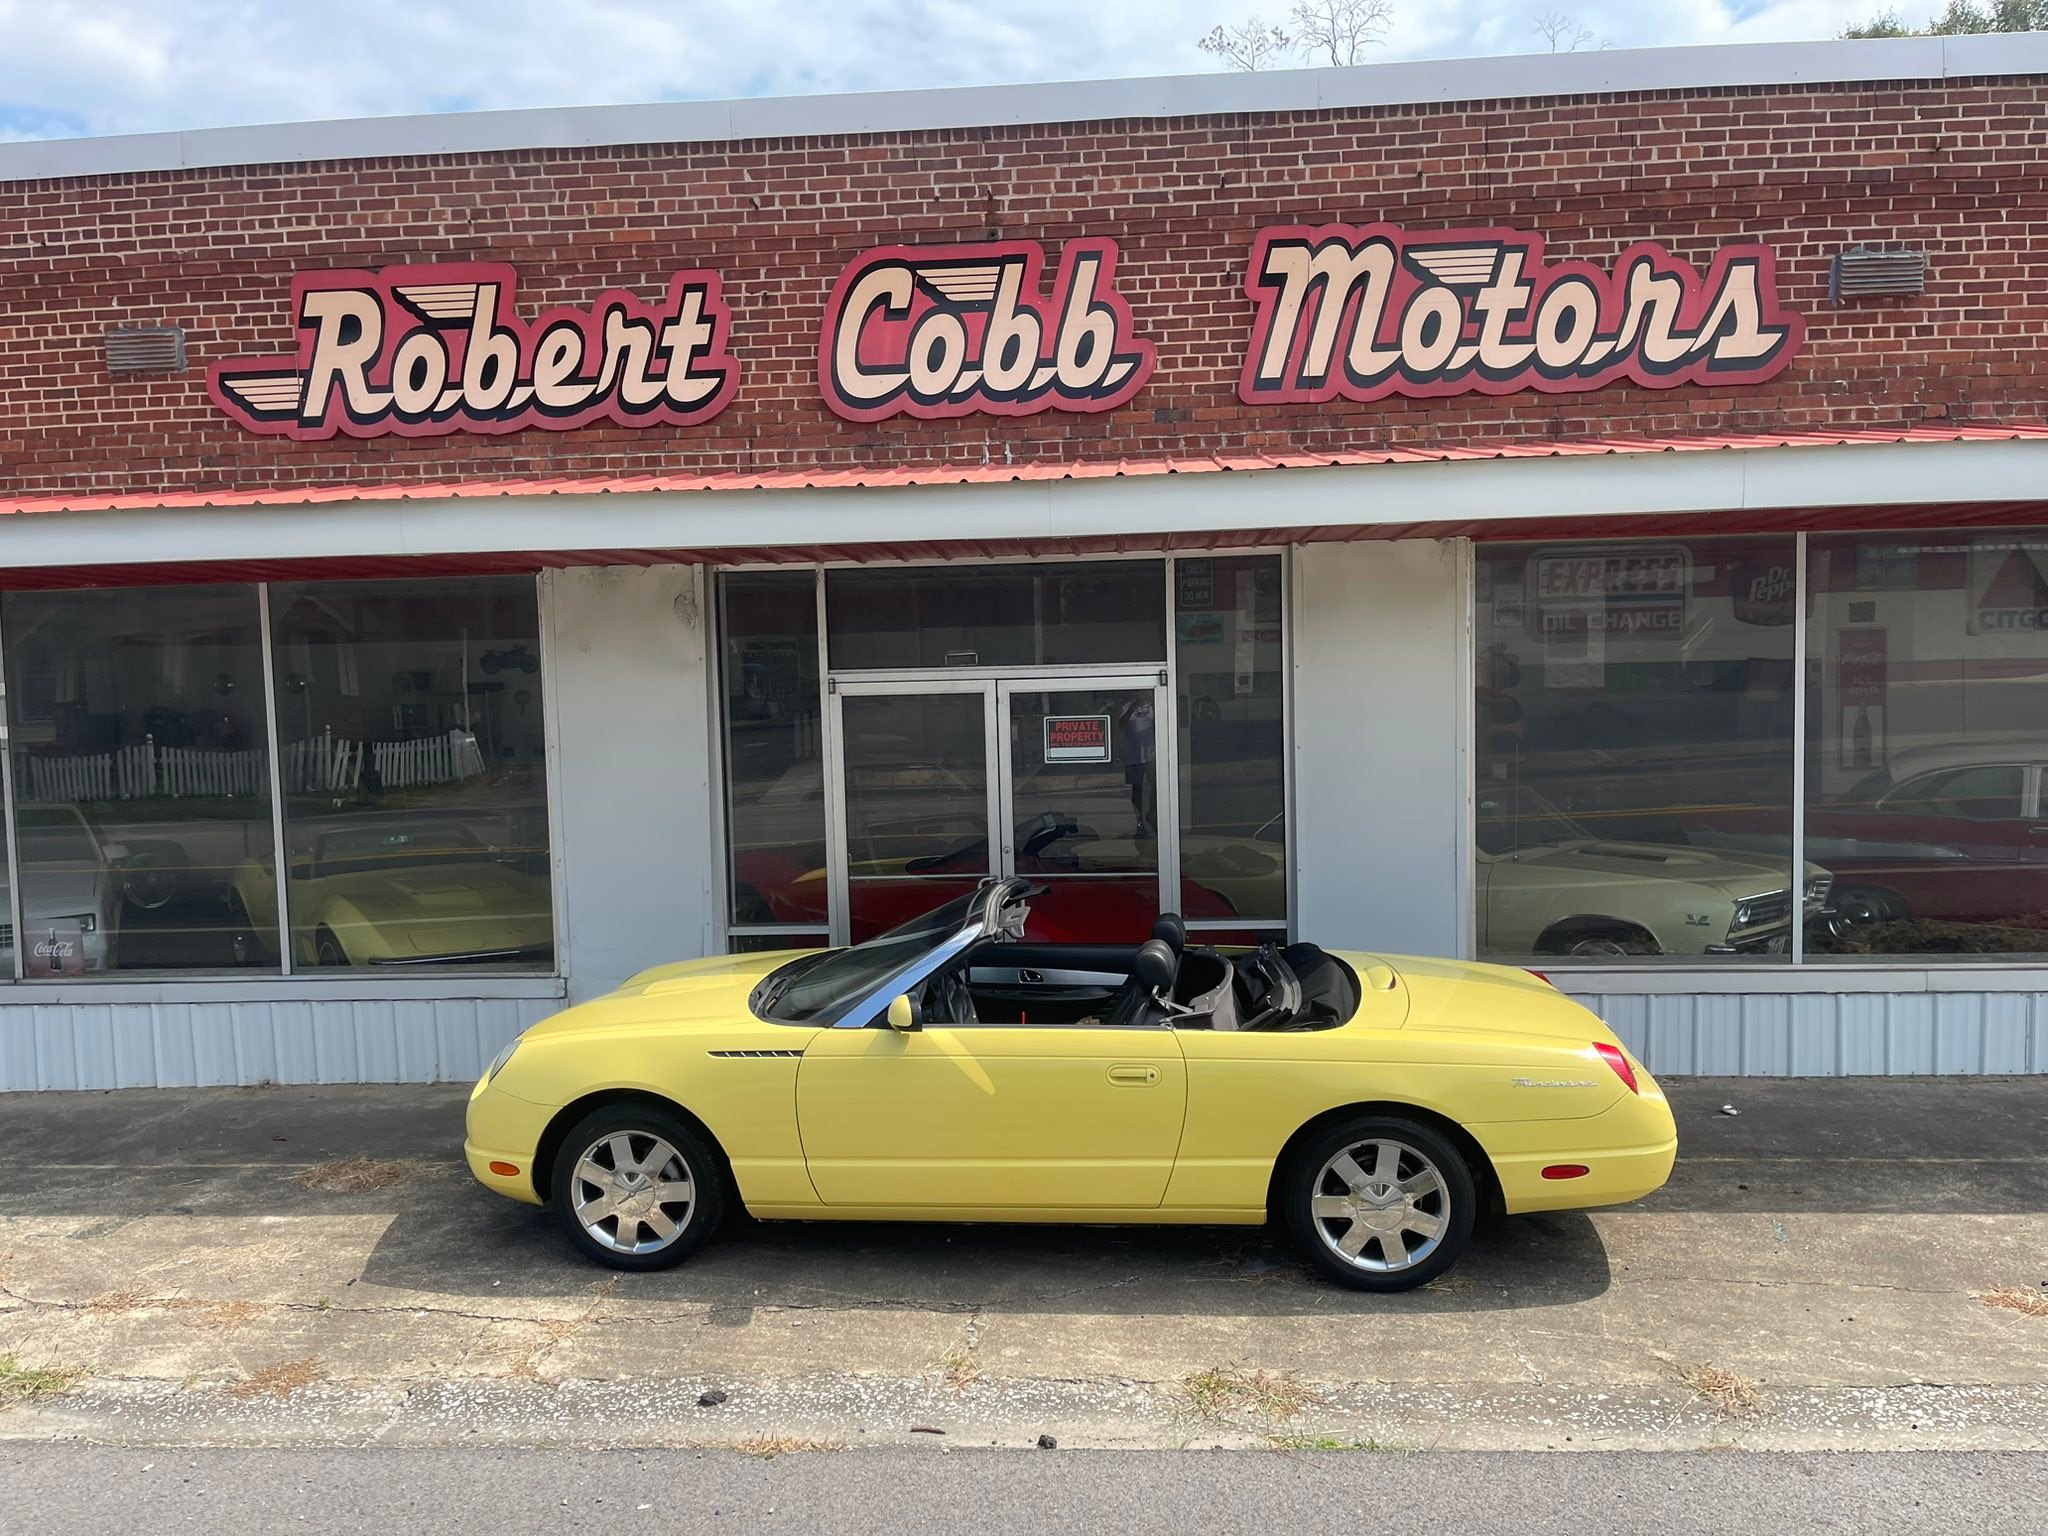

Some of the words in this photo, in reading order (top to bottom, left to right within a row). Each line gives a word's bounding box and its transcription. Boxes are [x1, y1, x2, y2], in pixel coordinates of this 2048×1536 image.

[301, 283, 721, 419] Robert
[836, 258, 1134, 400] Cobb
[1259, 243, 1783, 380] Motors
[1767, 566, 1792, 585] Dr
[1747, 576, 1794, 602] Pepp
[1543, 614, 1577, 631] OIL
[1586, 611, 1681, 630] CHANGE
[1979, 609, 2048, 631] CITGO
[1050, 731, 1104, 742] PROPERTY
[1055, 721, 1099, 732] PRIVATE
